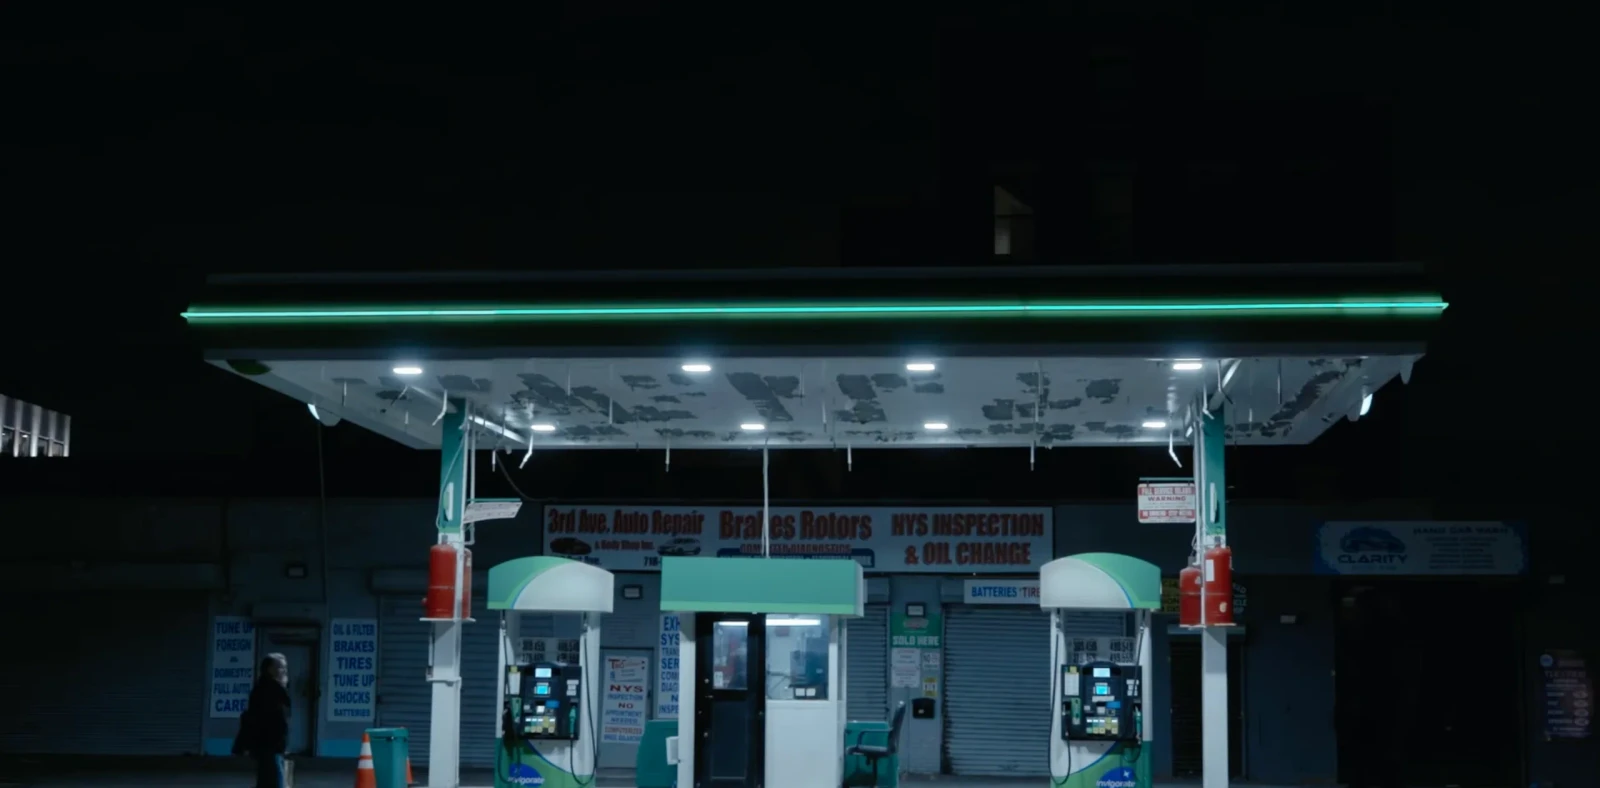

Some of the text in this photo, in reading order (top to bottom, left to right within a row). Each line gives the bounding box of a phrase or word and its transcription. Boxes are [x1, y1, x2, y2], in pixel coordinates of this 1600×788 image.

[548, 509, 575, 533] 3rd
[613, 510, 648, 533] Auto
[652, 510, 705, 536] Repair
[719, 510, 872, 540] Brakes Rotors
[891, 513, 1044, 536] NYS INSPECTION
[905, 542, 1031, 565] & OIL CHANGE
[1338, 554, 1408, 564] CLARITY
[971, 587, 1017, 598] BATTERIES
[216, 622, 254, 634] TUNE UP
[333, 624, 344, 636] OIL
[352, 624, 375, 636] FILTER
[216, 639, 251, 651] FOREIGN
[892, 635, 940, 646] SOLD HERE
[334, 641, 374, 653] BRAKES
[336, 657, 372, 670] TIRES
[214, 668, 252, 679] DOMESTIC
[333, 674, 375, 687] TUNE UP
[213, 683, 230, 694] FULL
[334, 692, 370, 704] SHOCKS
[215, 699, 246, 712] CARE
[334, 708, 370, 717] BATTERIES
[1096, 780, 1135, 788] invigorate
